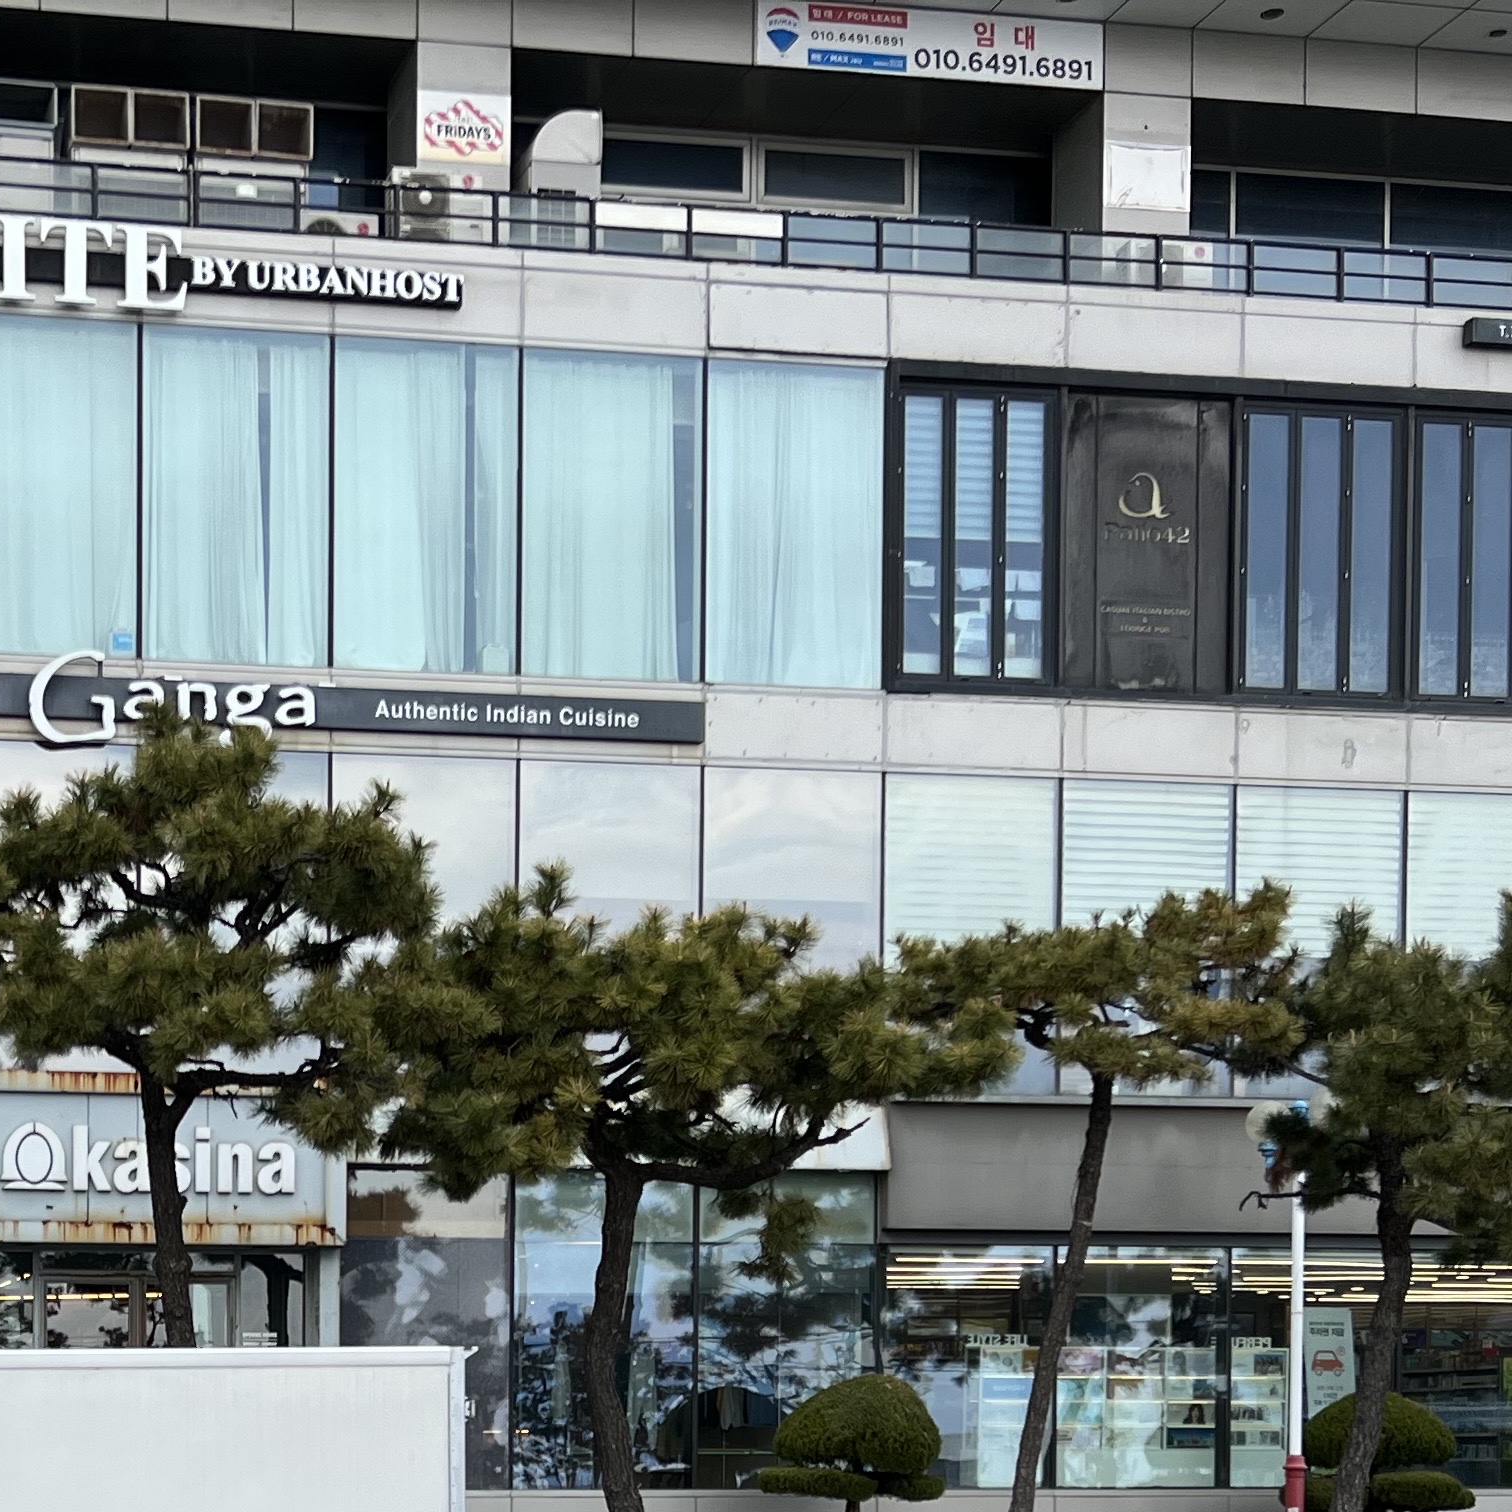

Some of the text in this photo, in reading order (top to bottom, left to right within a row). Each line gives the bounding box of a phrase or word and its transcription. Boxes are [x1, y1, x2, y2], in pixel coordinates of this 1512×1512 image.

[847, 11, 869, 22] FOR
[871, 12, 904, 25] LEASE
[811, 30, 905, 47] 010.6491.6891
[914, 48, 1094, 81] 010.6491.6891
[191, 256, 246, 288] BY
[246, 260, 465, 302] URBANHOST
[29, 650, 317, 748] Ganga
[375, 699, 640, 728] Authentic Indian Cuisine
